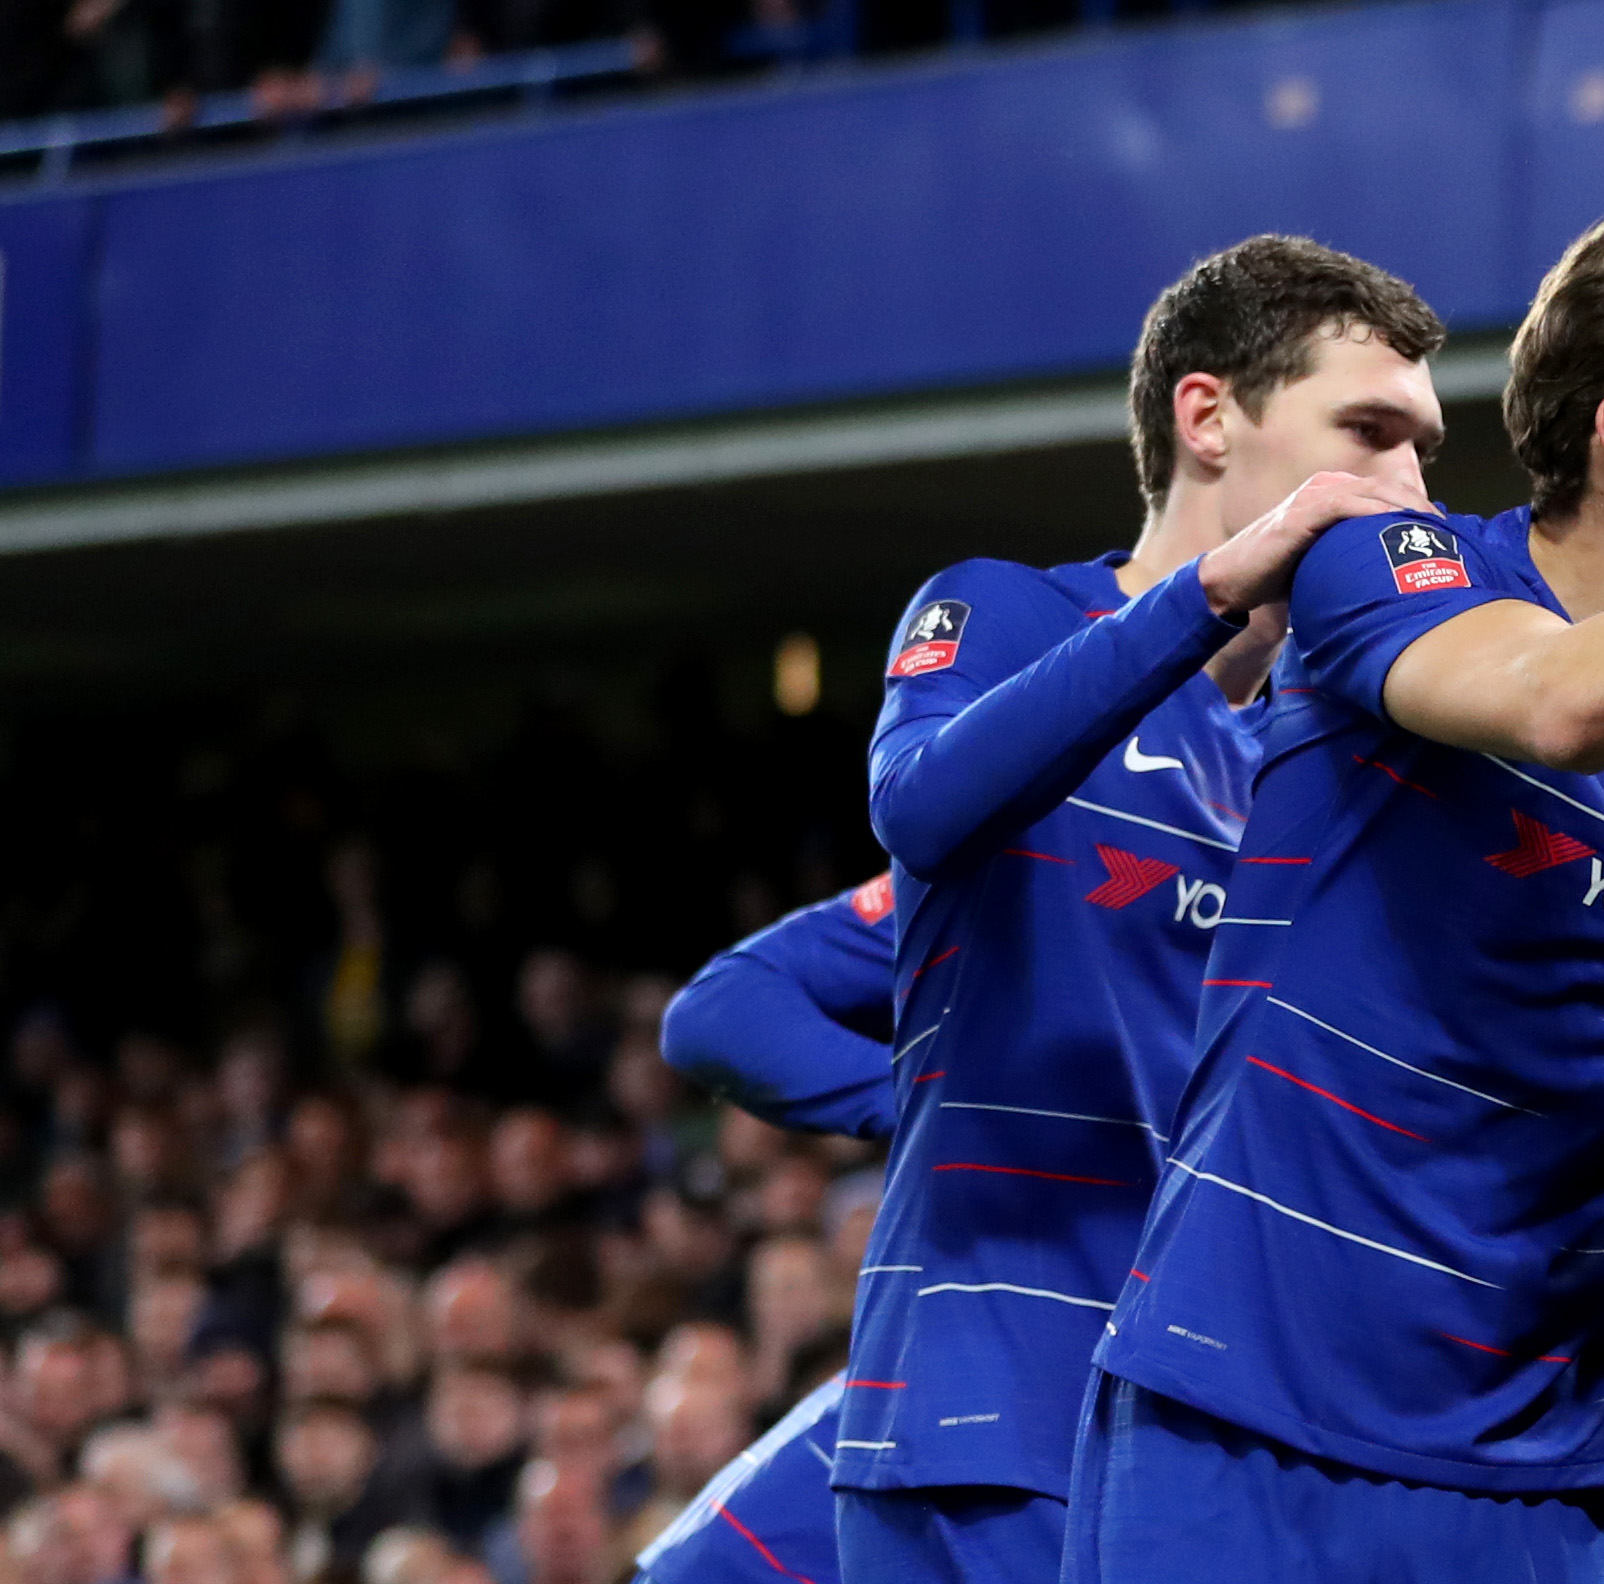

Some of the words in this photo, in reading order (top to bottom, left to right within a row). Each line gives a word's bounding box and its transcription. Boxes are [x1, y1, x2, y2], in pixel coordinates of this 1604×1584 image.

[1405, 567, 1459, 584] Emirates
[1415, 578, 1430, 589] FA
[1430, 575, 1454, 584] CUP
